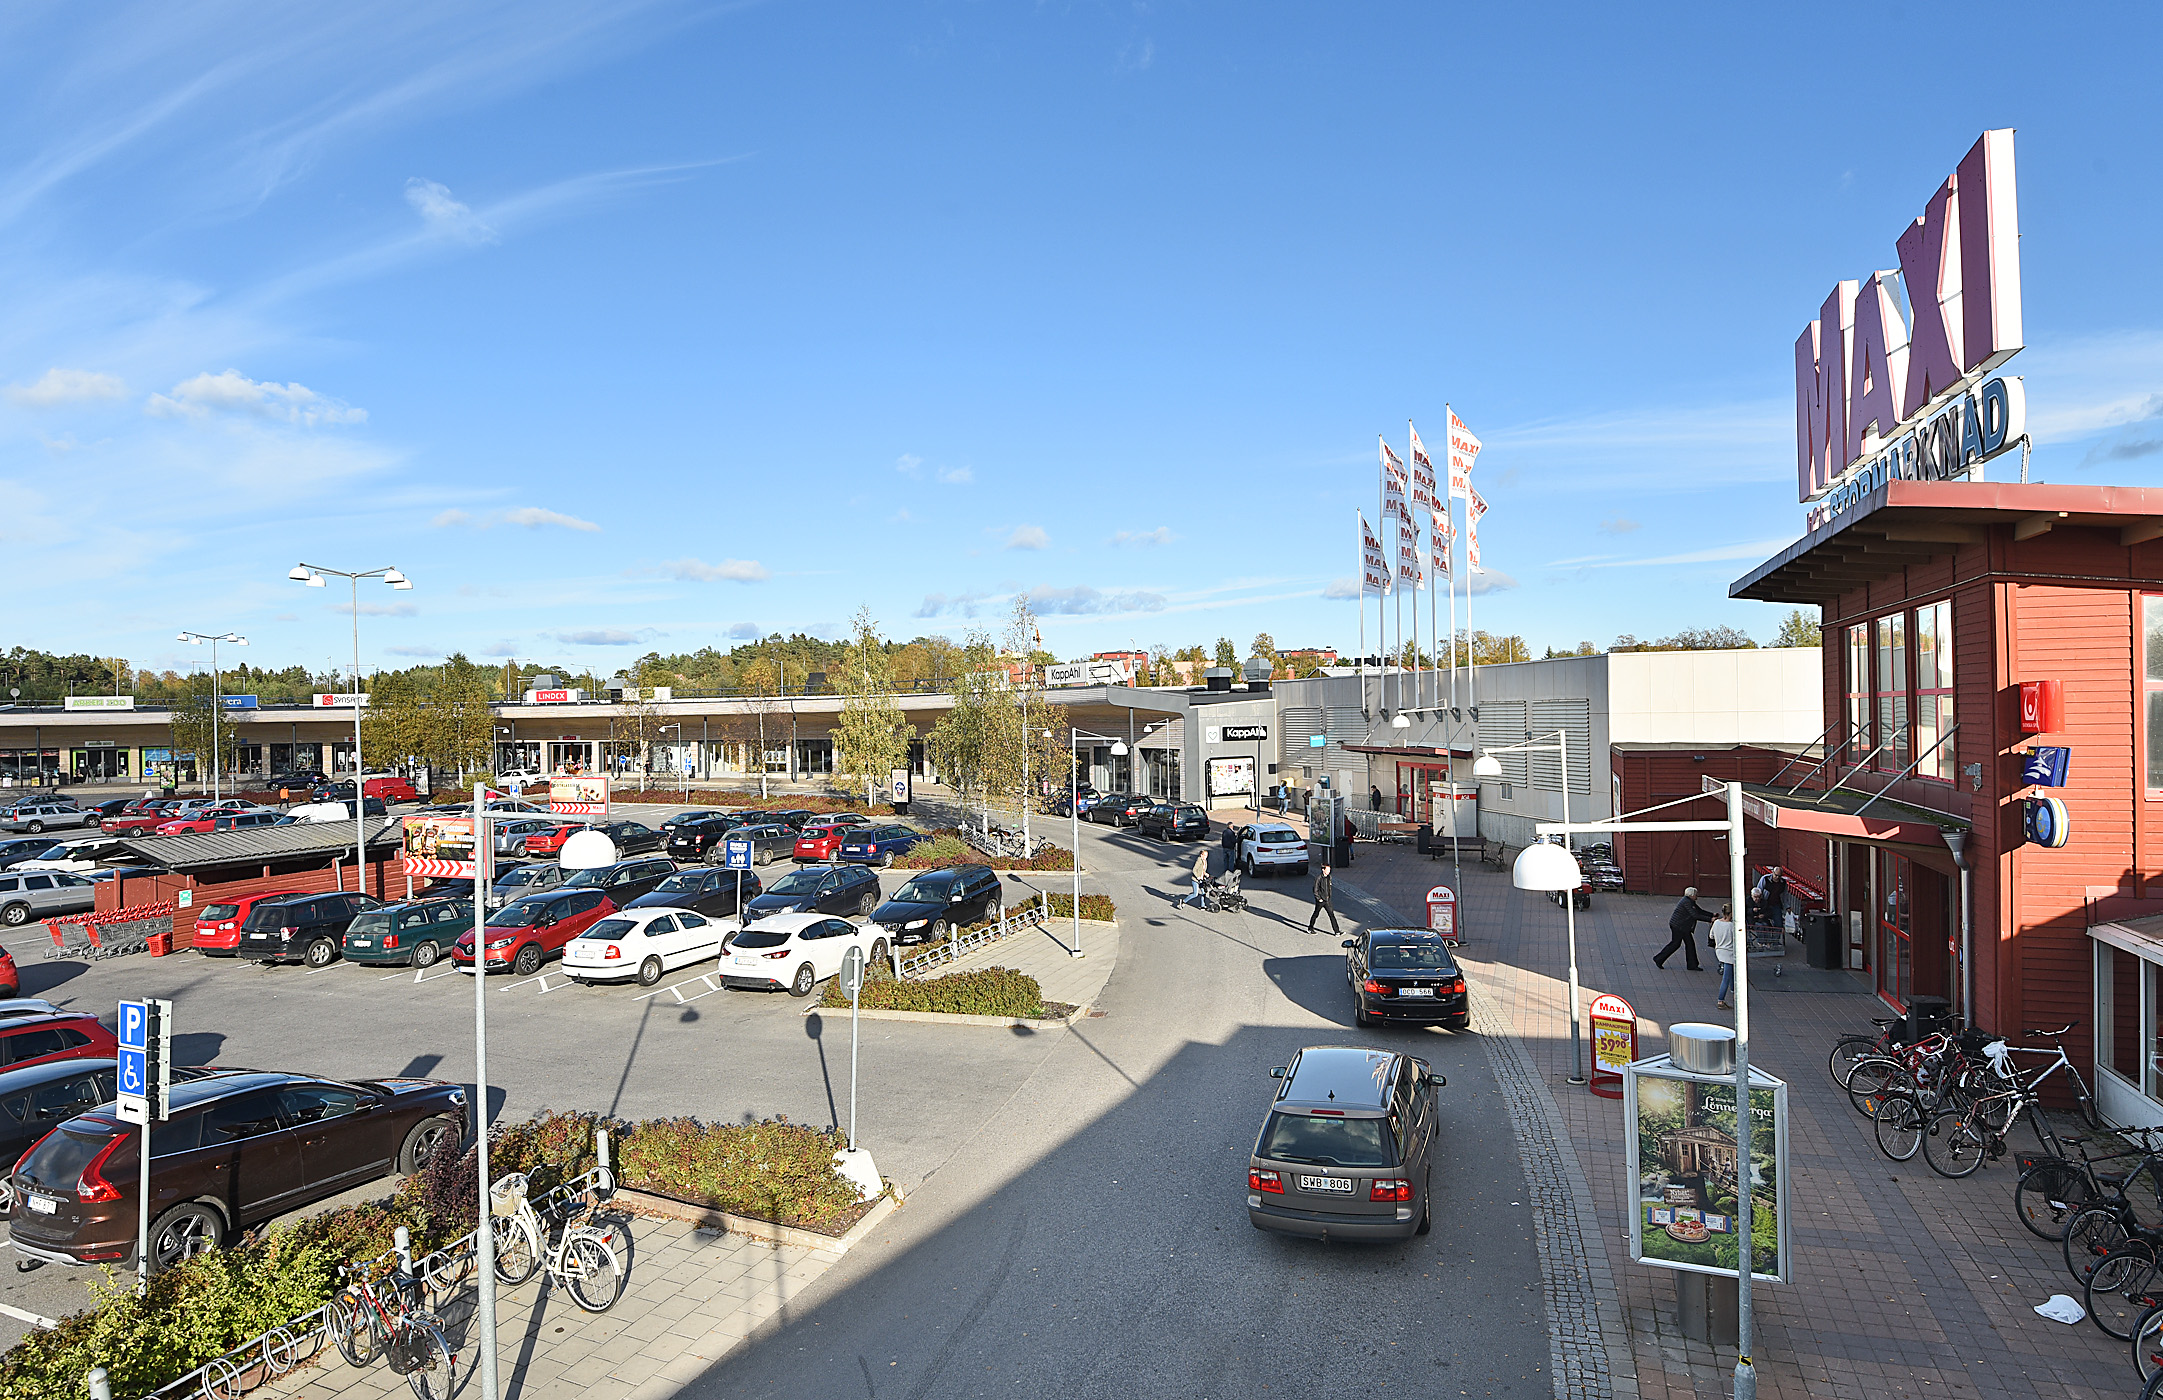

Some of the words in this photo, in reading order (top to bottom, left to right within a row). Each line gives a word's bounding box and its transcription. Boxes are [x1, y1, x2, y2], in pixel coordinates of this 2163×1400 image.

[1795, 129, 2023, 503] MAXI
[1051, 667, 1081, 682] KappAhl
[1599, 1002, 1625, 1014] MAXI
[126, 1006, 141, 1043] P
[1701, 1095, 1772, 1120] Lönnerga
[1303, 1176, 1322, 1188] SWB
[1329, 1178, 1350, 1190] 806
